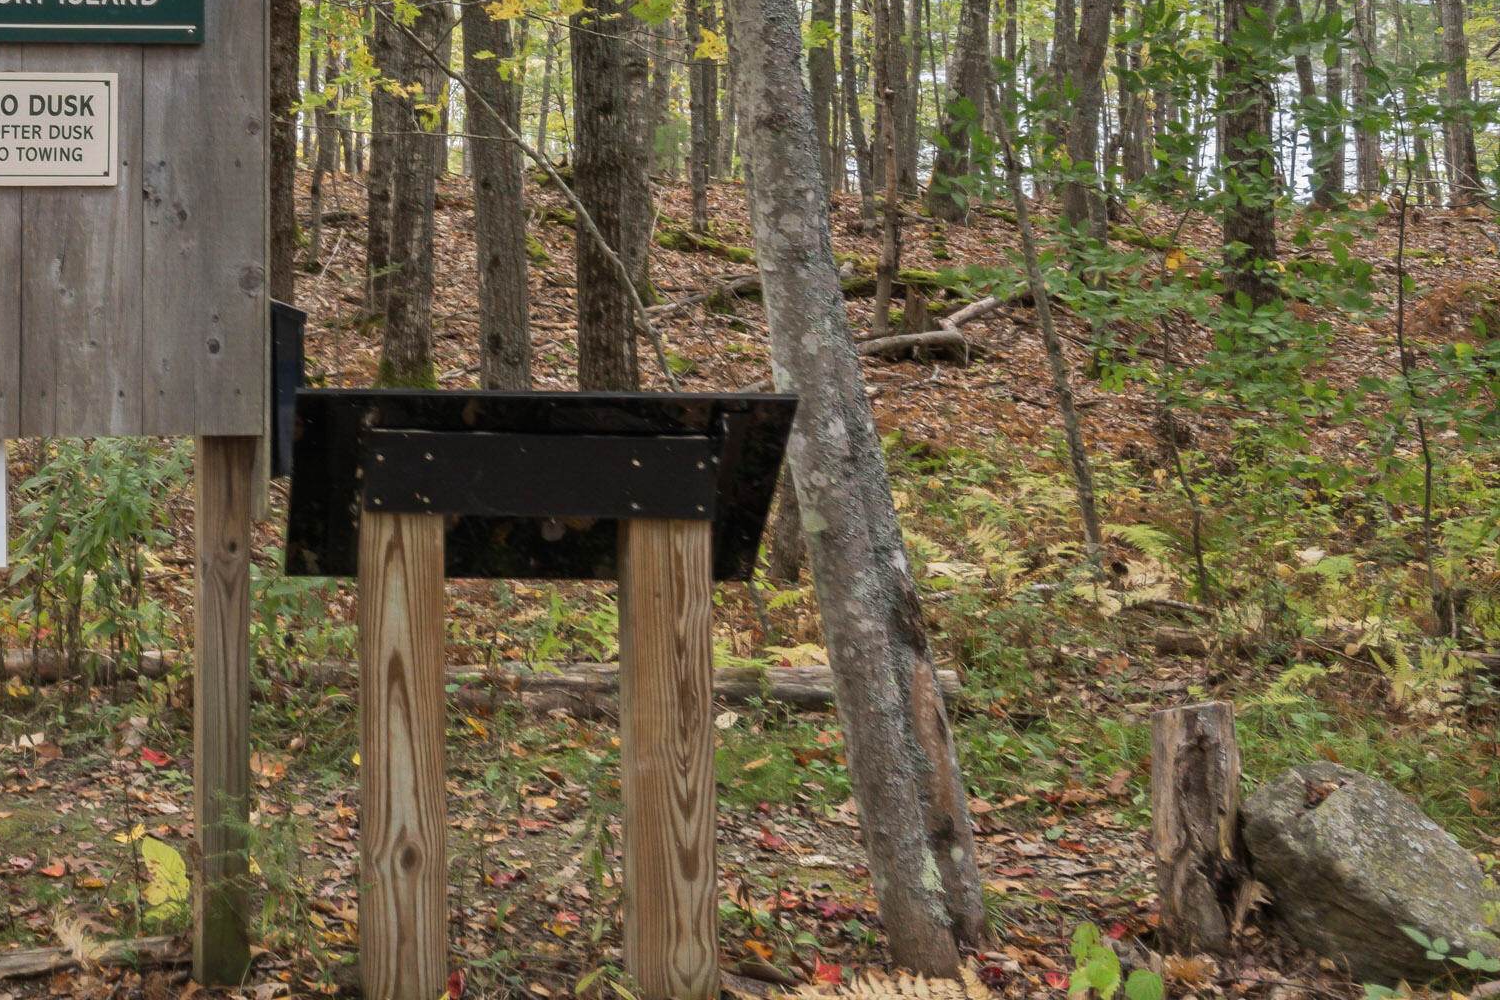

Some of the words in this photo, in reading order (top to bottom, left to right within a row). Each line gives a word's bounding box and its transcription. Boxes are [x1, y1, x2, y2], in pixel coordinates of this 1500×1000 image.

[29, 94, 95, 117] DUSK
[48, 124, 94, 140] DUSK
[15, 146, 83, 162] TOWING
